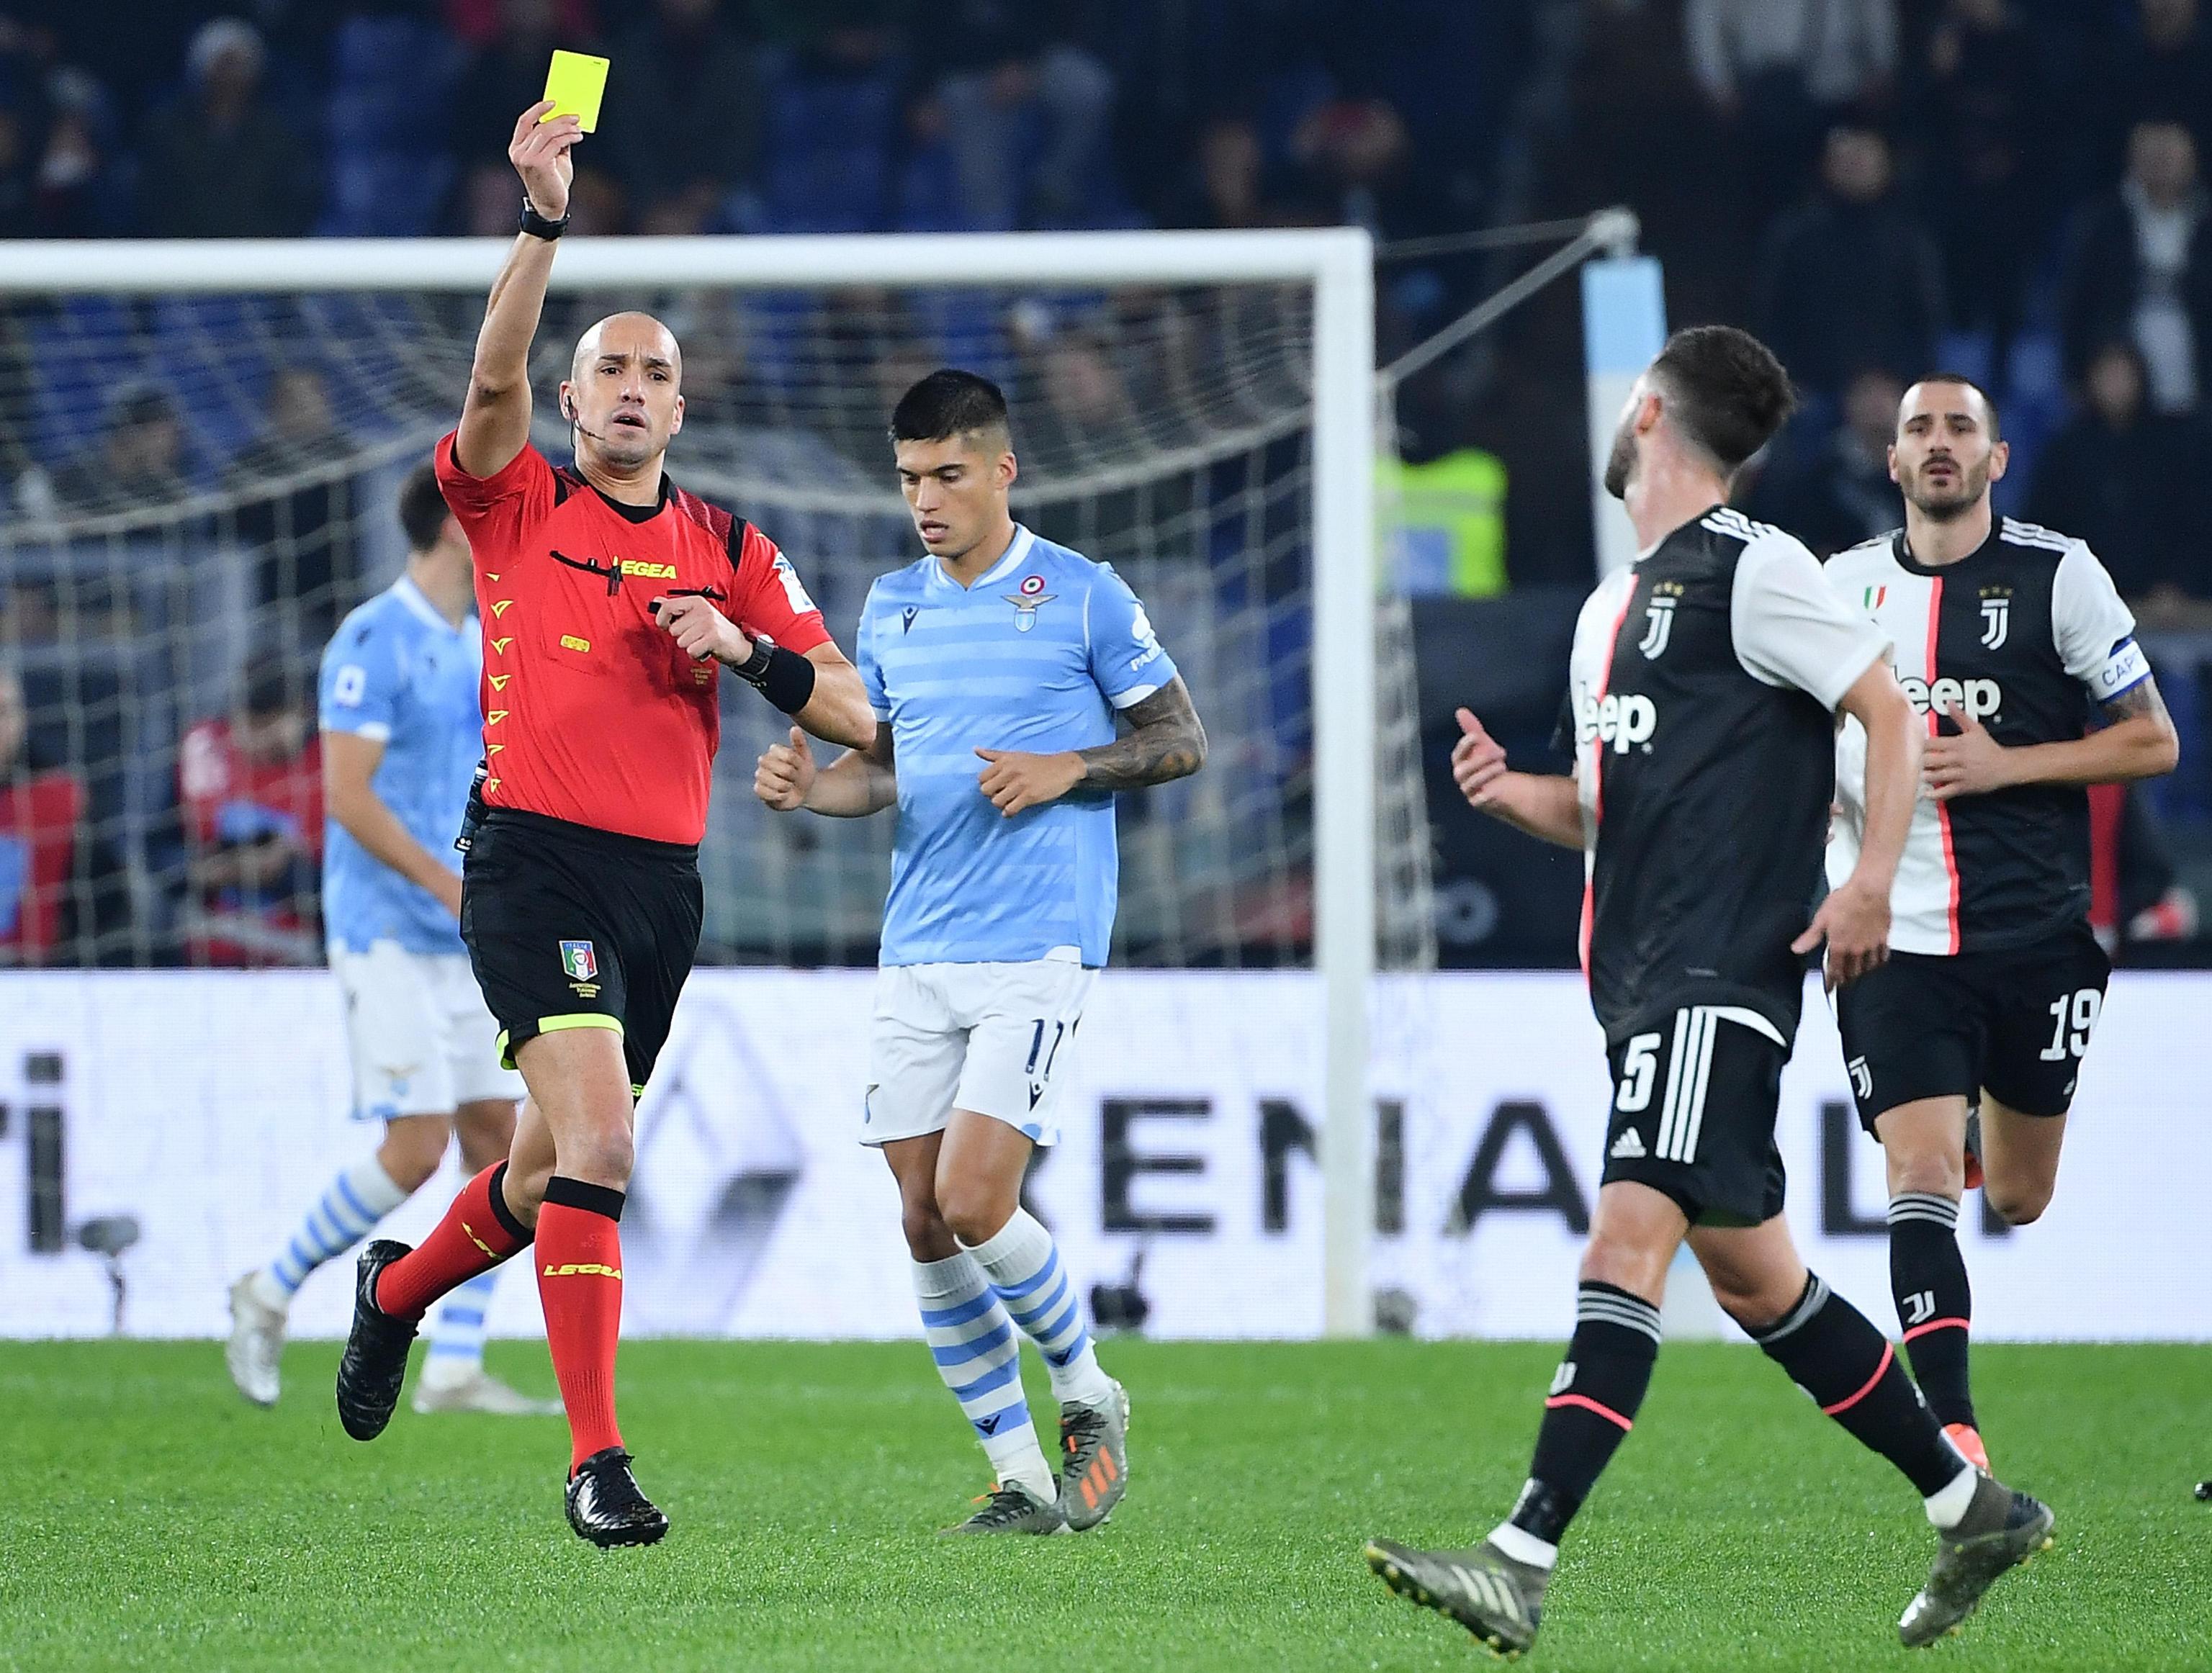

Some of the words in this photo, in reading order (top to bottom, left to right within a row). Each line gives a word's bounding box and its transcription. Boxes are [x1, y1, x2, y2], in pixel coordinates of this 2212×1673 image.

[1894, 665, 2002, 724] eep
[2101, 649, 2139, 687] CAP
[1025, 1018, 1065, 1082] 11
[2039, 988, 2102, 1061] 19
[1617, 1032, 1662, 1112] 5
